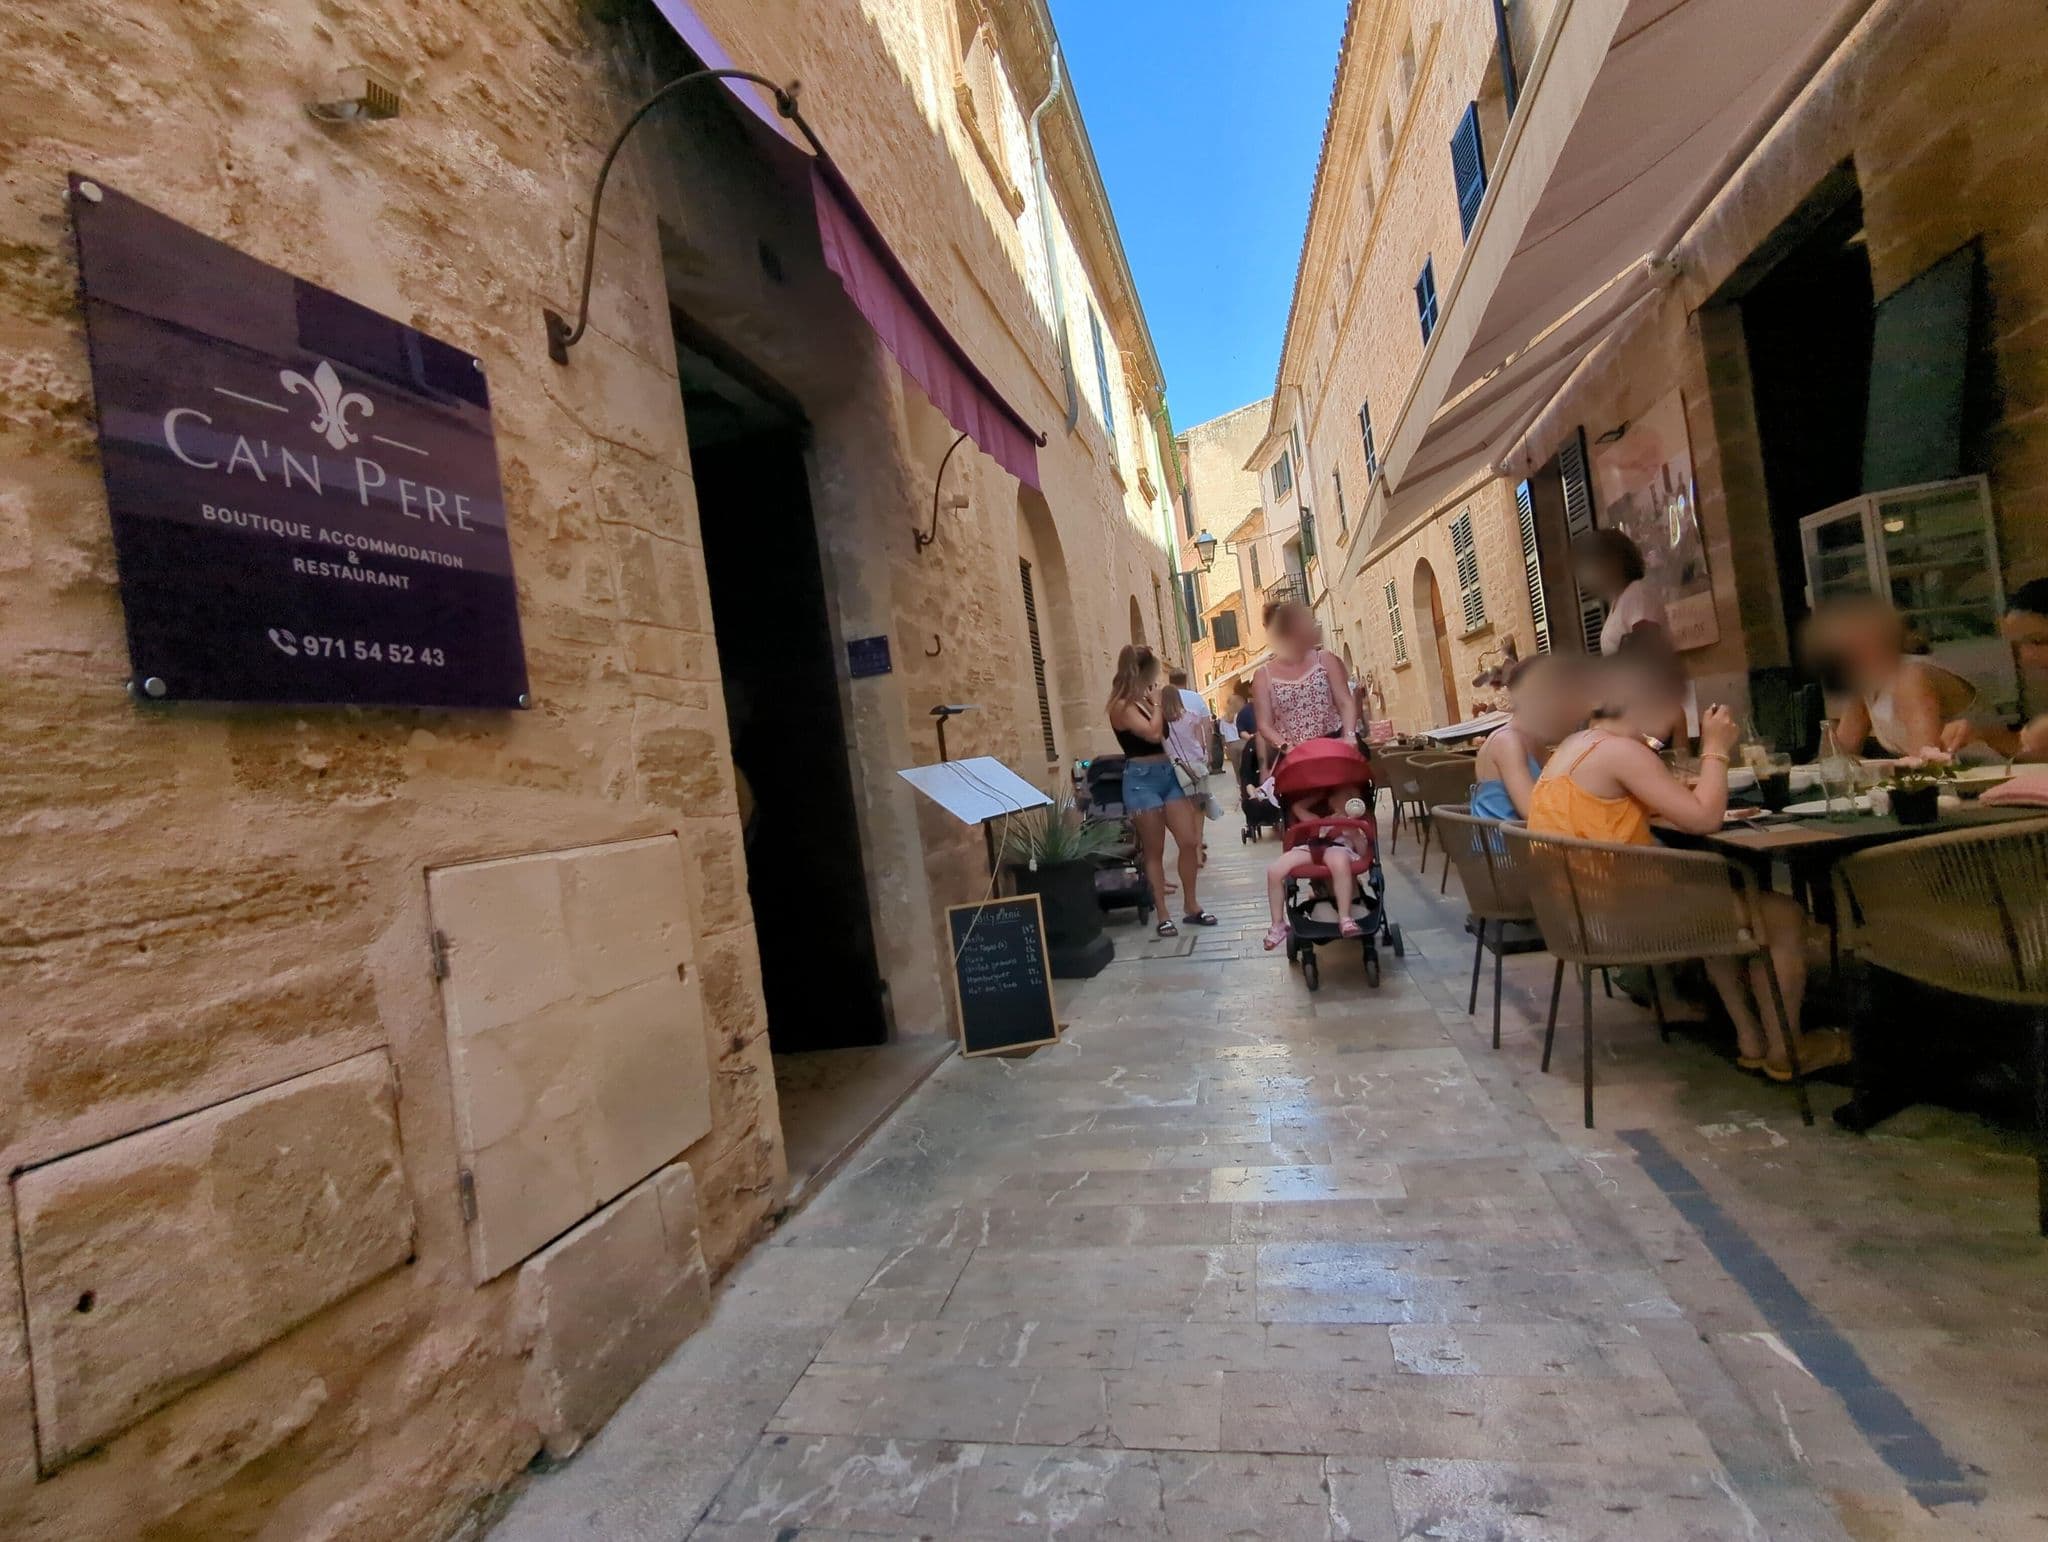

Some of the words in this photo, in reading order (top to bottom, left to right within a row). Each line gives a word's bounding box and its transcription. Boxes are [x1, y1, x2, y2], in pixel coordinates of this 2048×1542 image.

[163, 407, 323, 496] CA'N
[355, 456, 475, 532] PERE
[202, 503, 312, 540] BOUTIQUE
[319, 528, 464, 569] ACCOMMODATION
[293, 557, 410, 590] RESTAURANT
[347, 550, 360, 565] &
[302, 635, 347, 659] 971
[353, 640, 383, 661] 54
[388, 643, 415, 664] 52
[420, 647, 446, 667] 43
